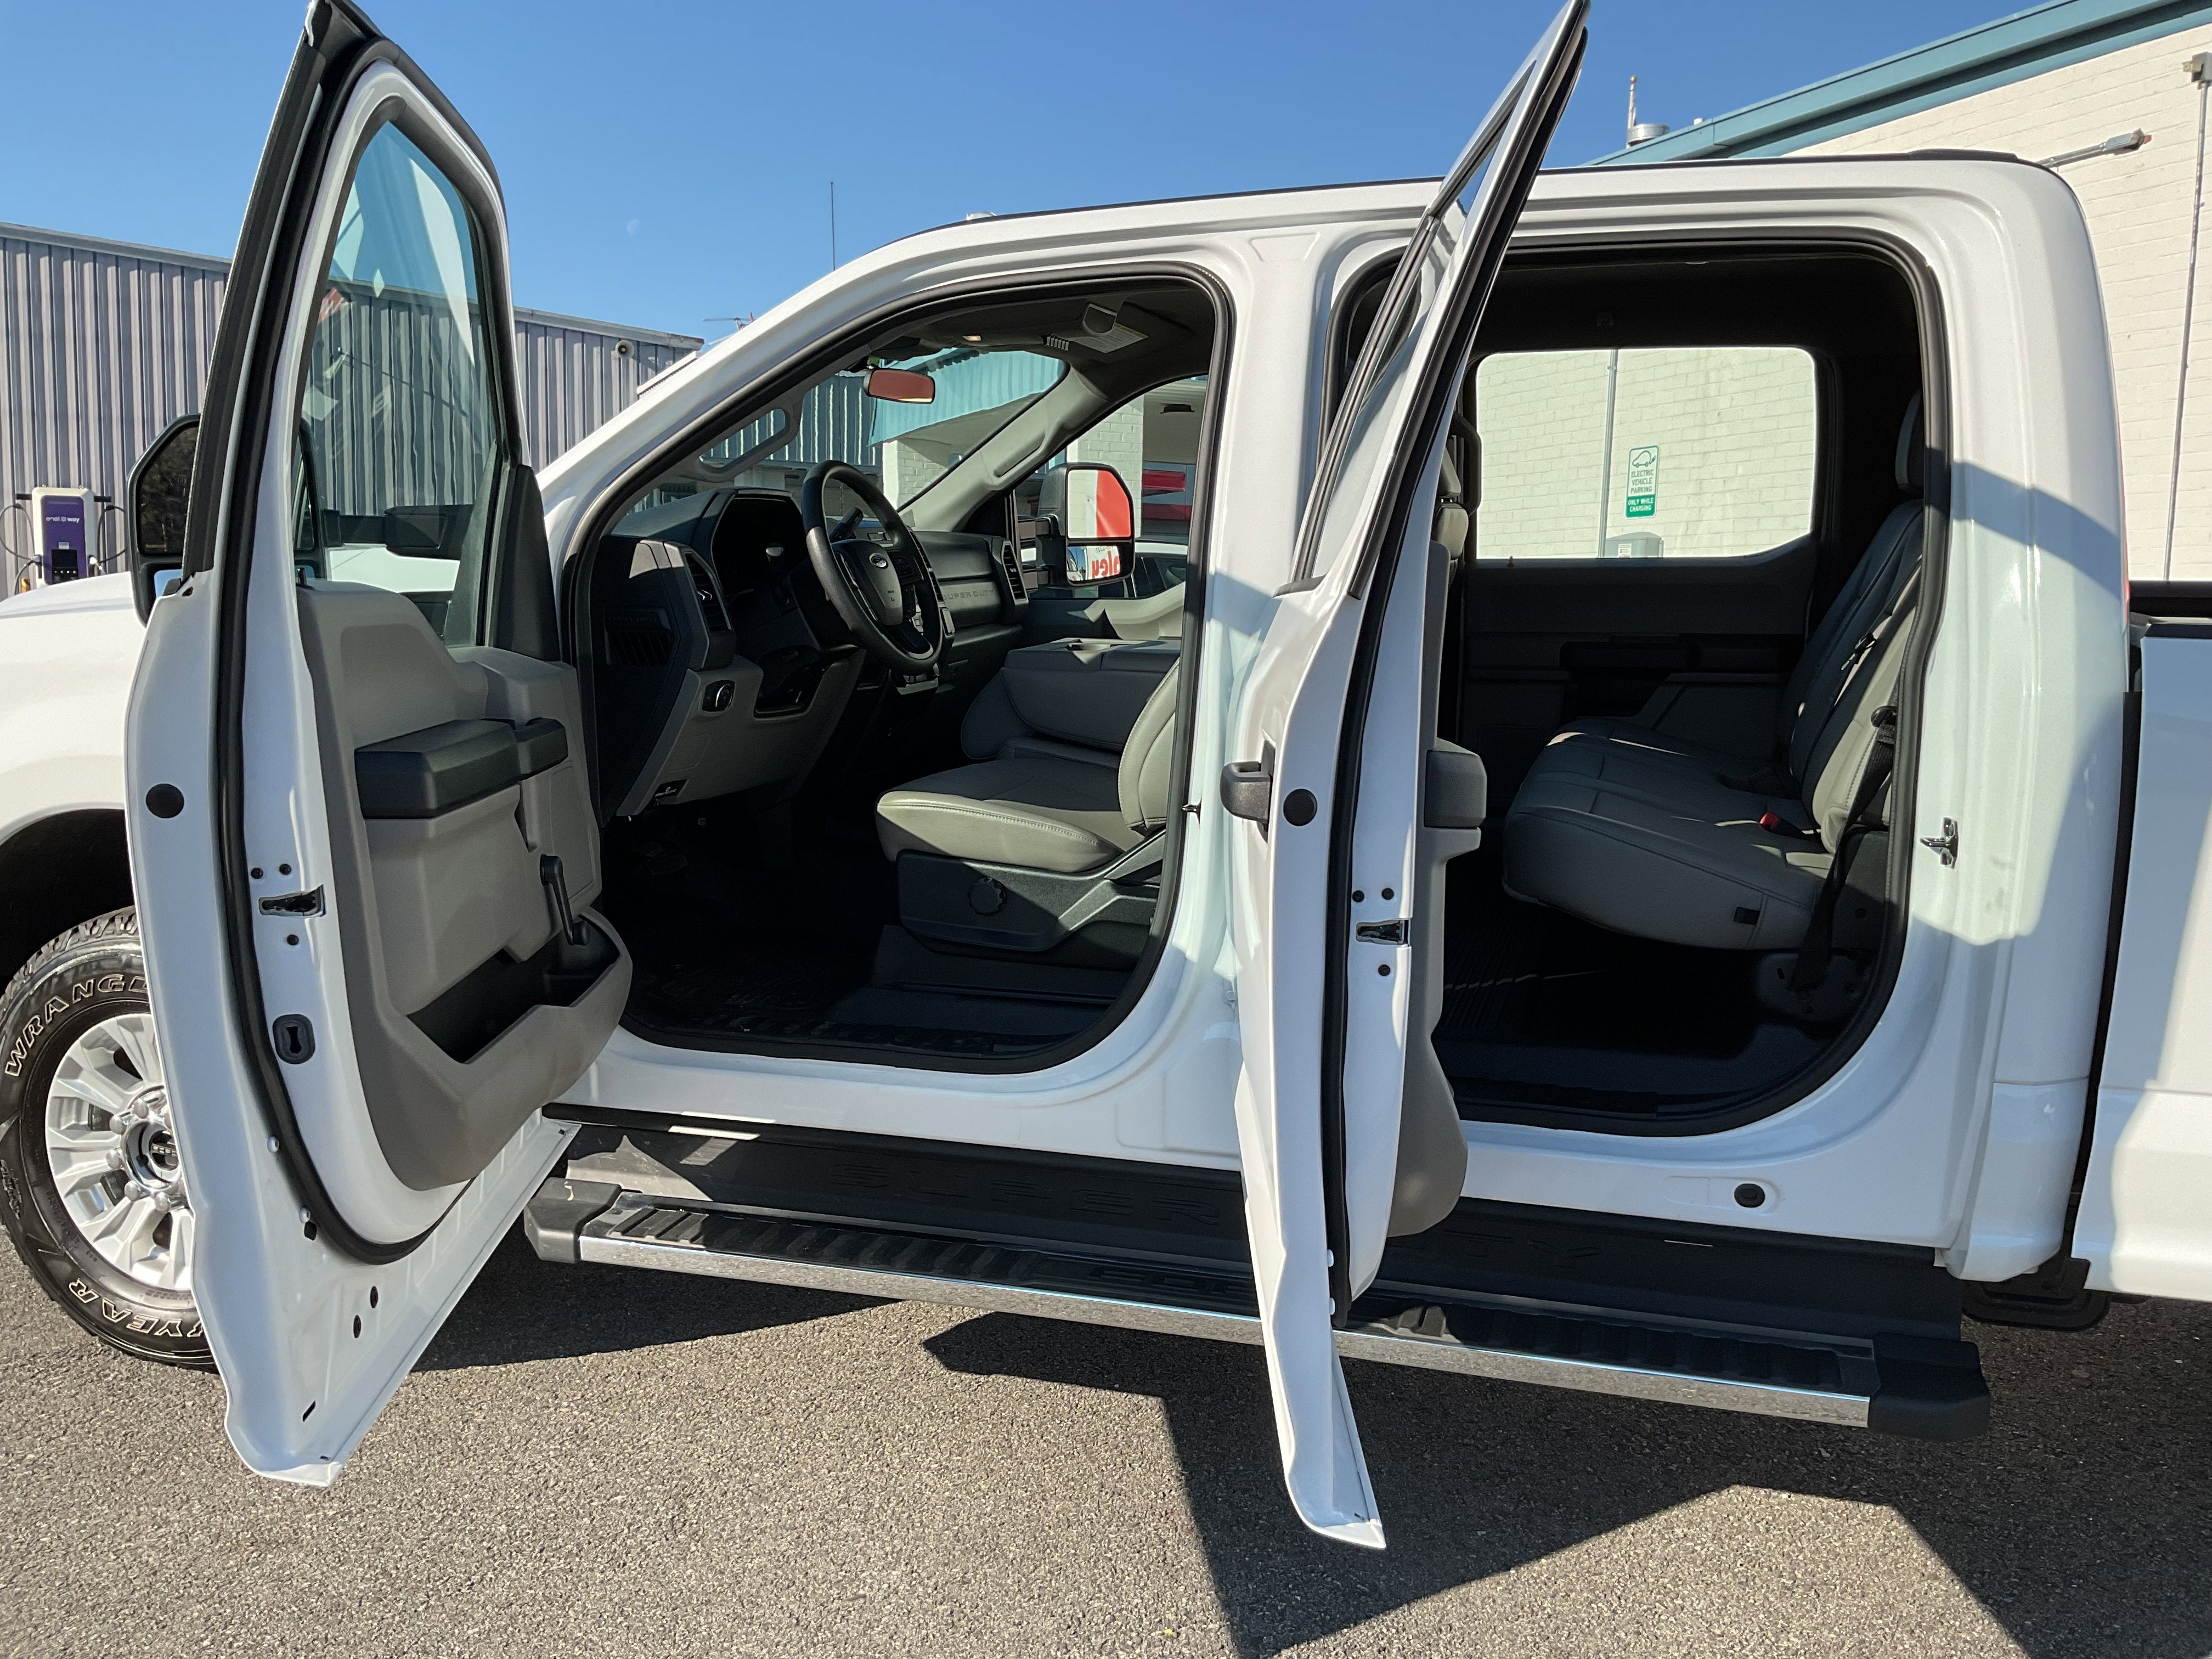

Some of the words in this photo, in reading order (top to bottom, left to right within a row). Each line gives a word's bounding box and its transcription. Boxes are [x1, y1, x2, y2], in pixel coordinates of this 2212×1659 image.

[1631, 469, 1654, 477] ELECTRIC
[1632, 477, 1652, 486] VEHICLE
[4, 974, 148, 1076] WRANGL
[68, 1277, 183, 1338] YEAR
